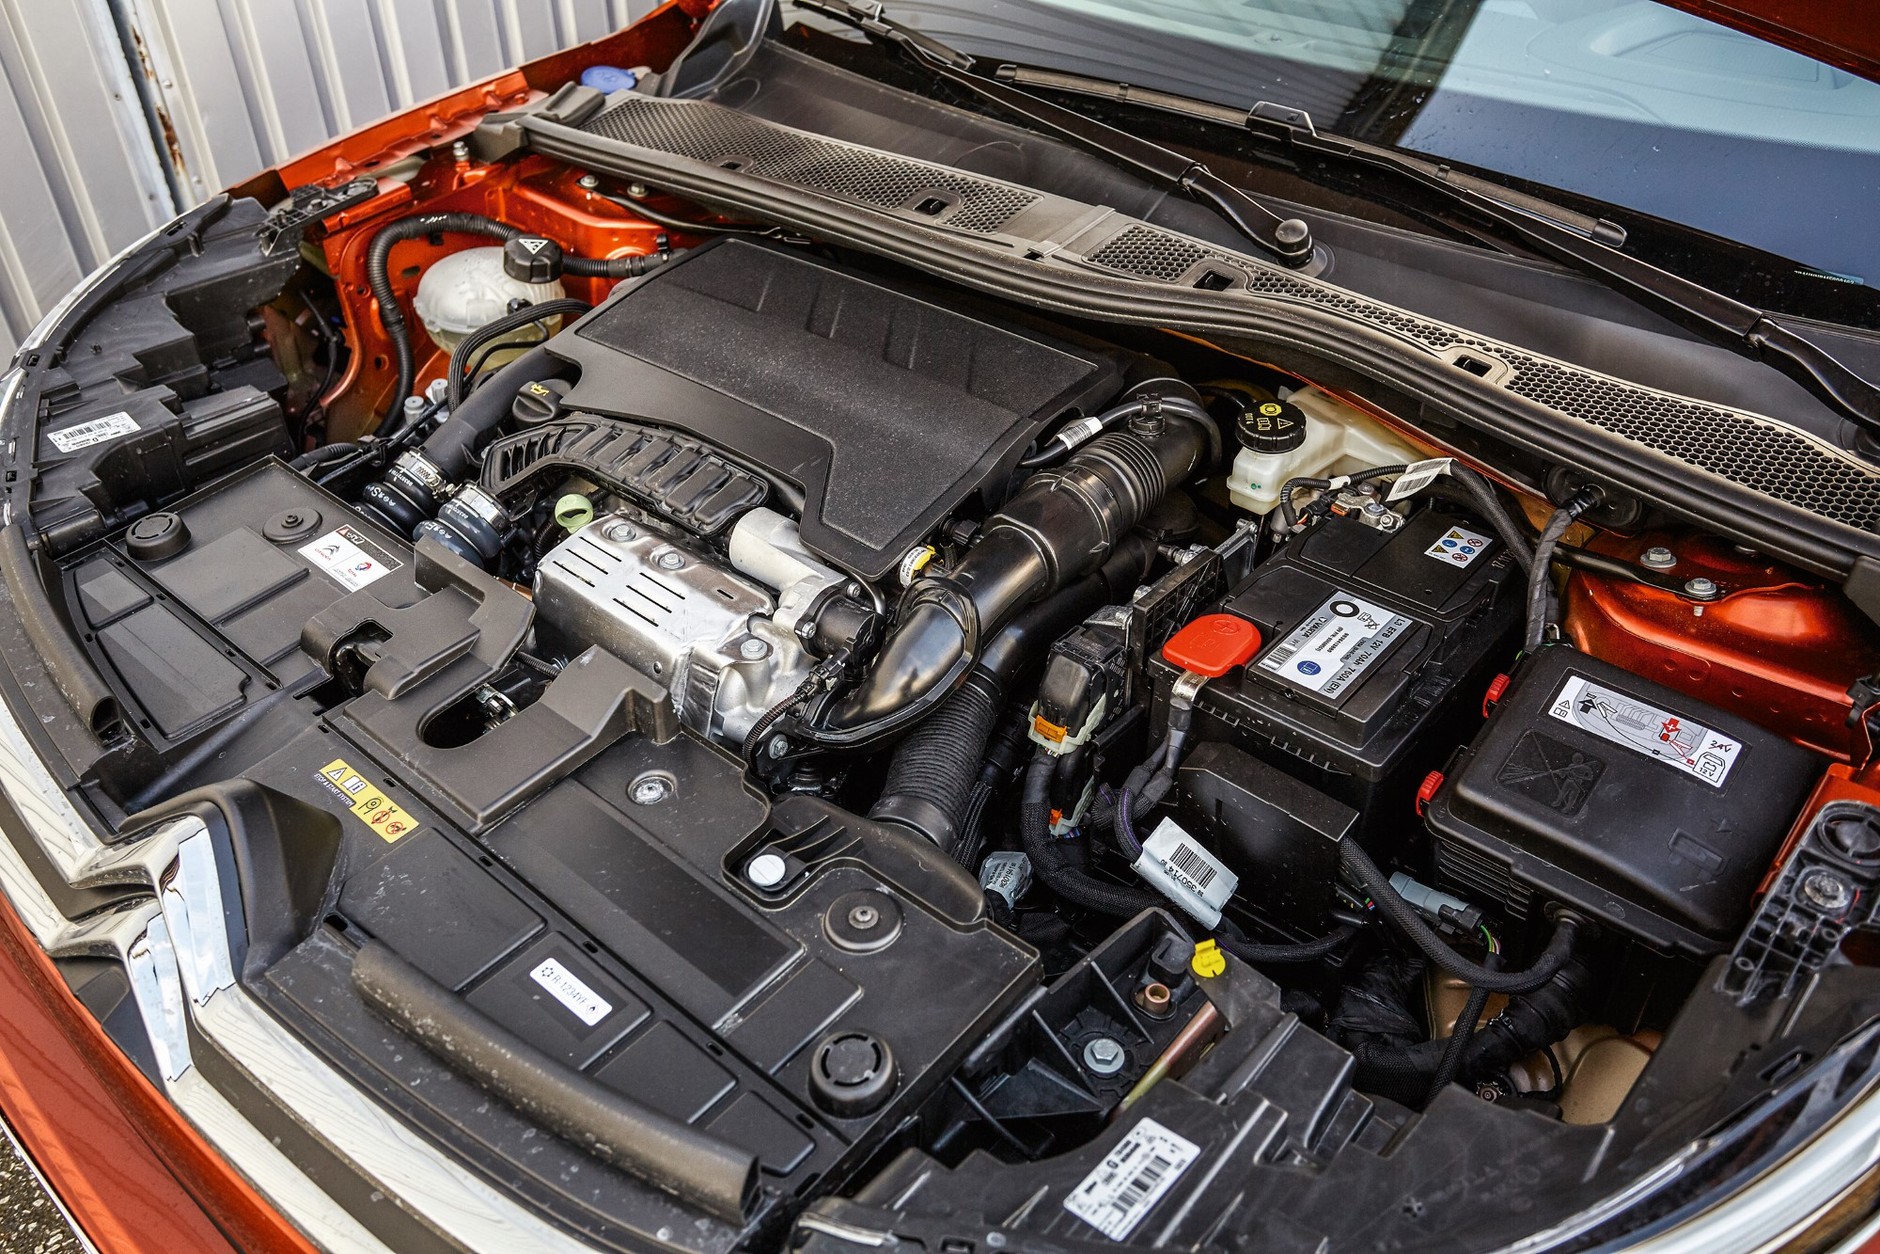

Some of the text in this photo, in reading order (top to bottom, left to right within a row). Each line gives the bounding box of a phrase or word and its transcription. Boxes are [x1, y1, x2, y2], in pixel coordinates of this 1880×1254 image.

[1302, 622, 1323, 638] VARTA
[1394, 618, 1406, 628] L3
[1383, 627, 1397, 639] EFB
[1371, 639, 1384, 651] 12V
[1355, 651, 1372, 666] 70Ah
[1340, 666, 1356, 682] 760A
[1324, 680, 1341, 694] (EN)
[1168, 865, 1198, 893] 350714
[551, 974, 588, 1005] R-1234YF
